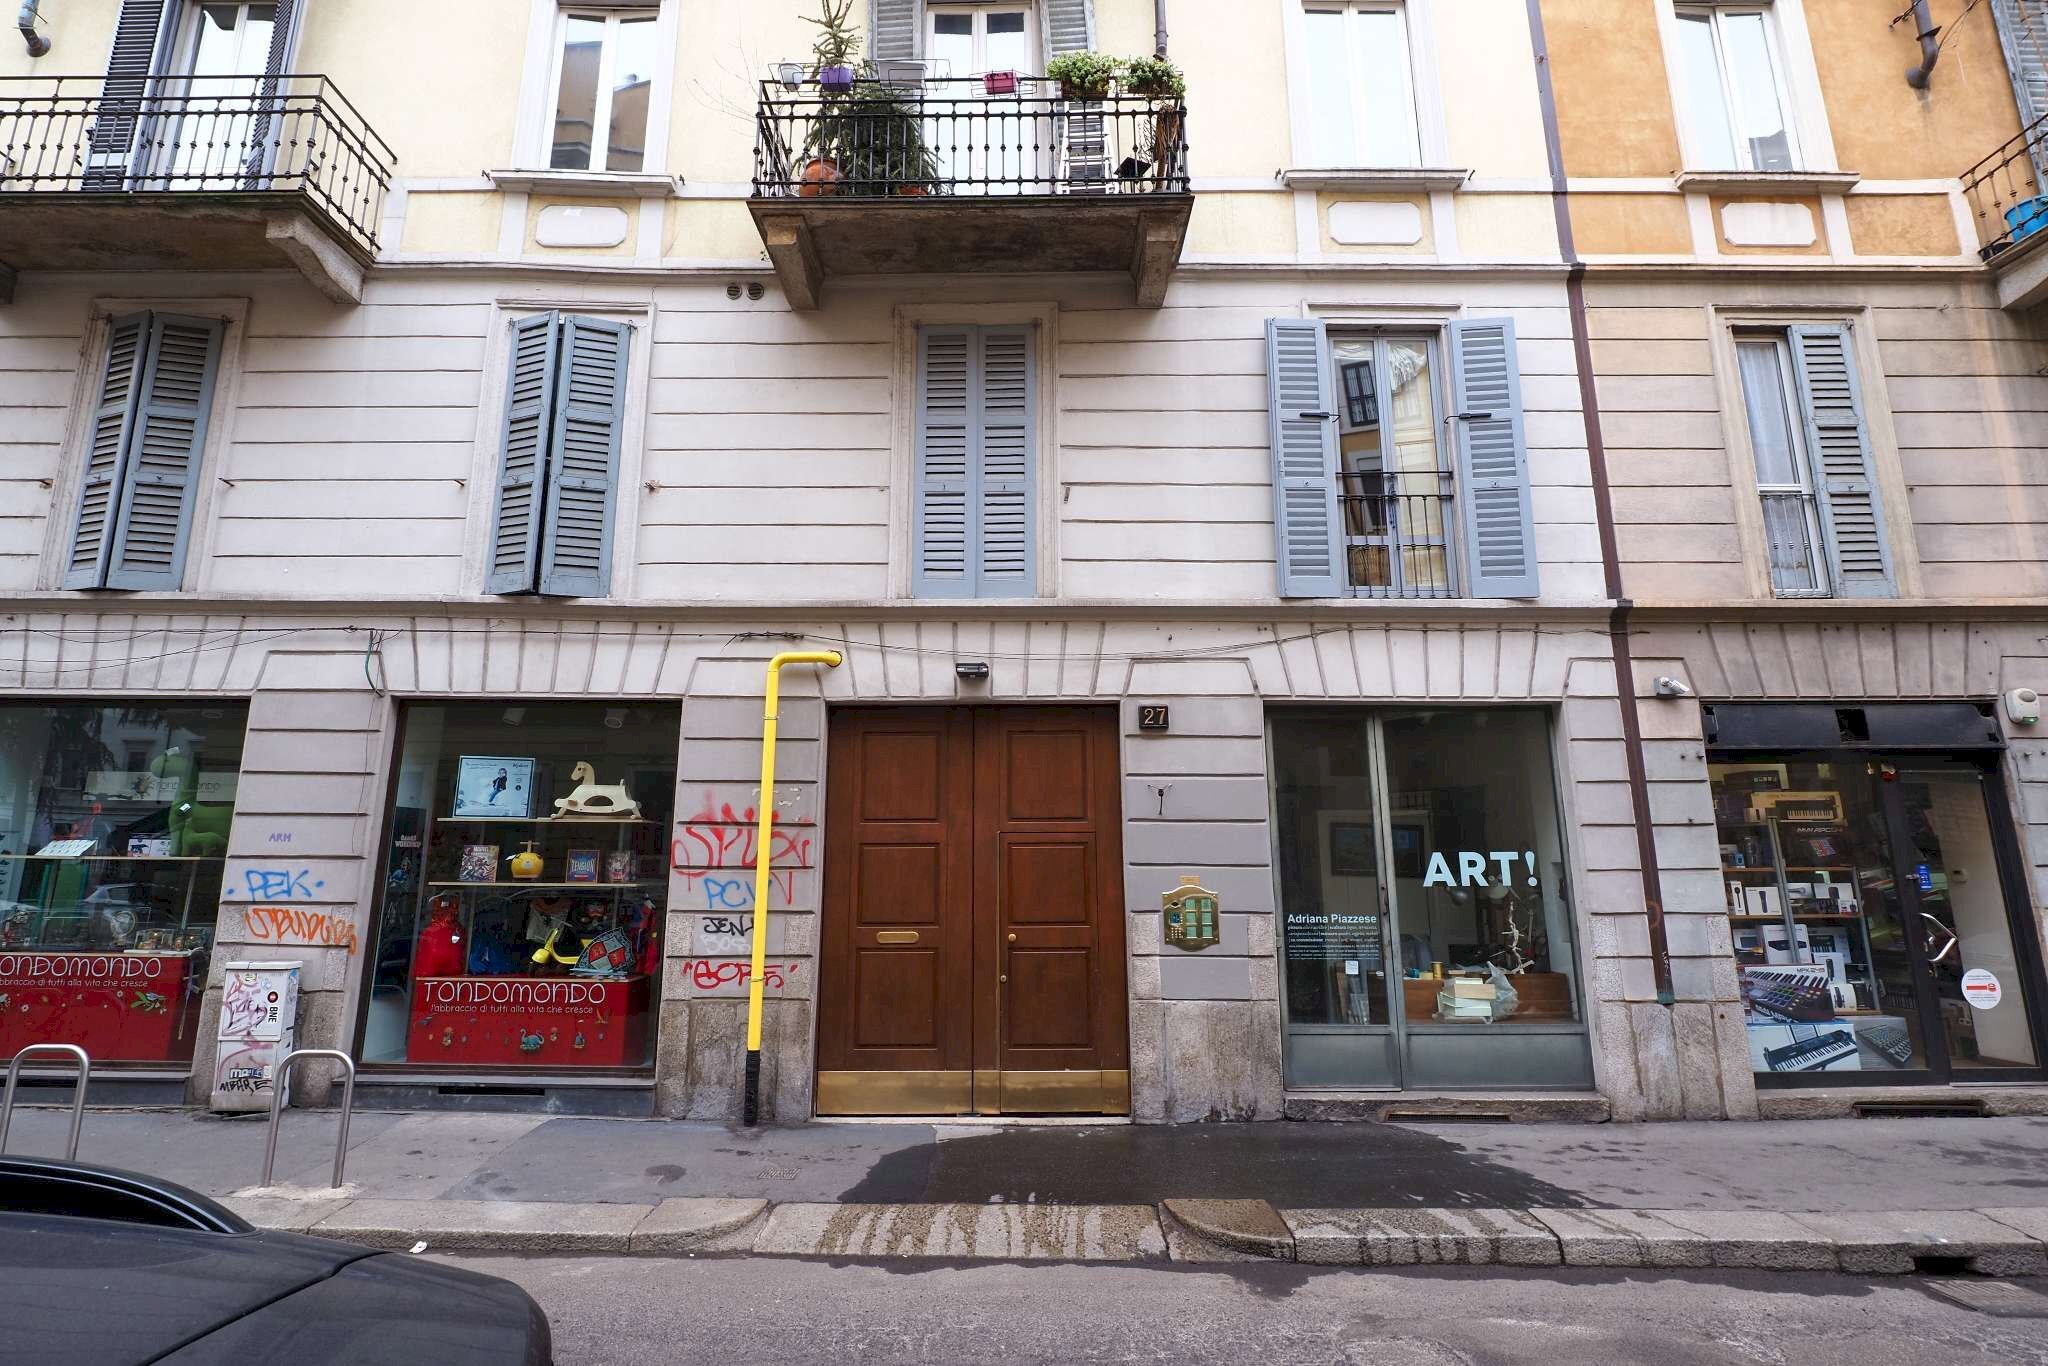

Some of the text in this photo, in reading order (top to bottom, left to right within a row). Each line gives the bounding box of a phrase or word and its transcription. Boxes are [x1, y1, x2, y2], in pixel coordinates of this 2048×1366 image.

[1144, 708, 1165, 724] 27
[1423, 851, 1538, 887] ART!
[1288, 914, 1377, 923] Adriana Piazzese
[48, 978, 65, 987] tutti
[68, 979, 82, 987] alla
[85, 979, 100, 987] vita
[103, 979, 118, 987] che
[121, 980, 148, 988] cresce
[479, 1004, 488, 1013] di
[490, 1004, 508, 1013] tutti
[510, 1004, 525, 1013] alla
[527, 1005, 544, 1014] vita
[547, 1005, 562, 1014] che
[565, 1006, 593, 1014] cresce
